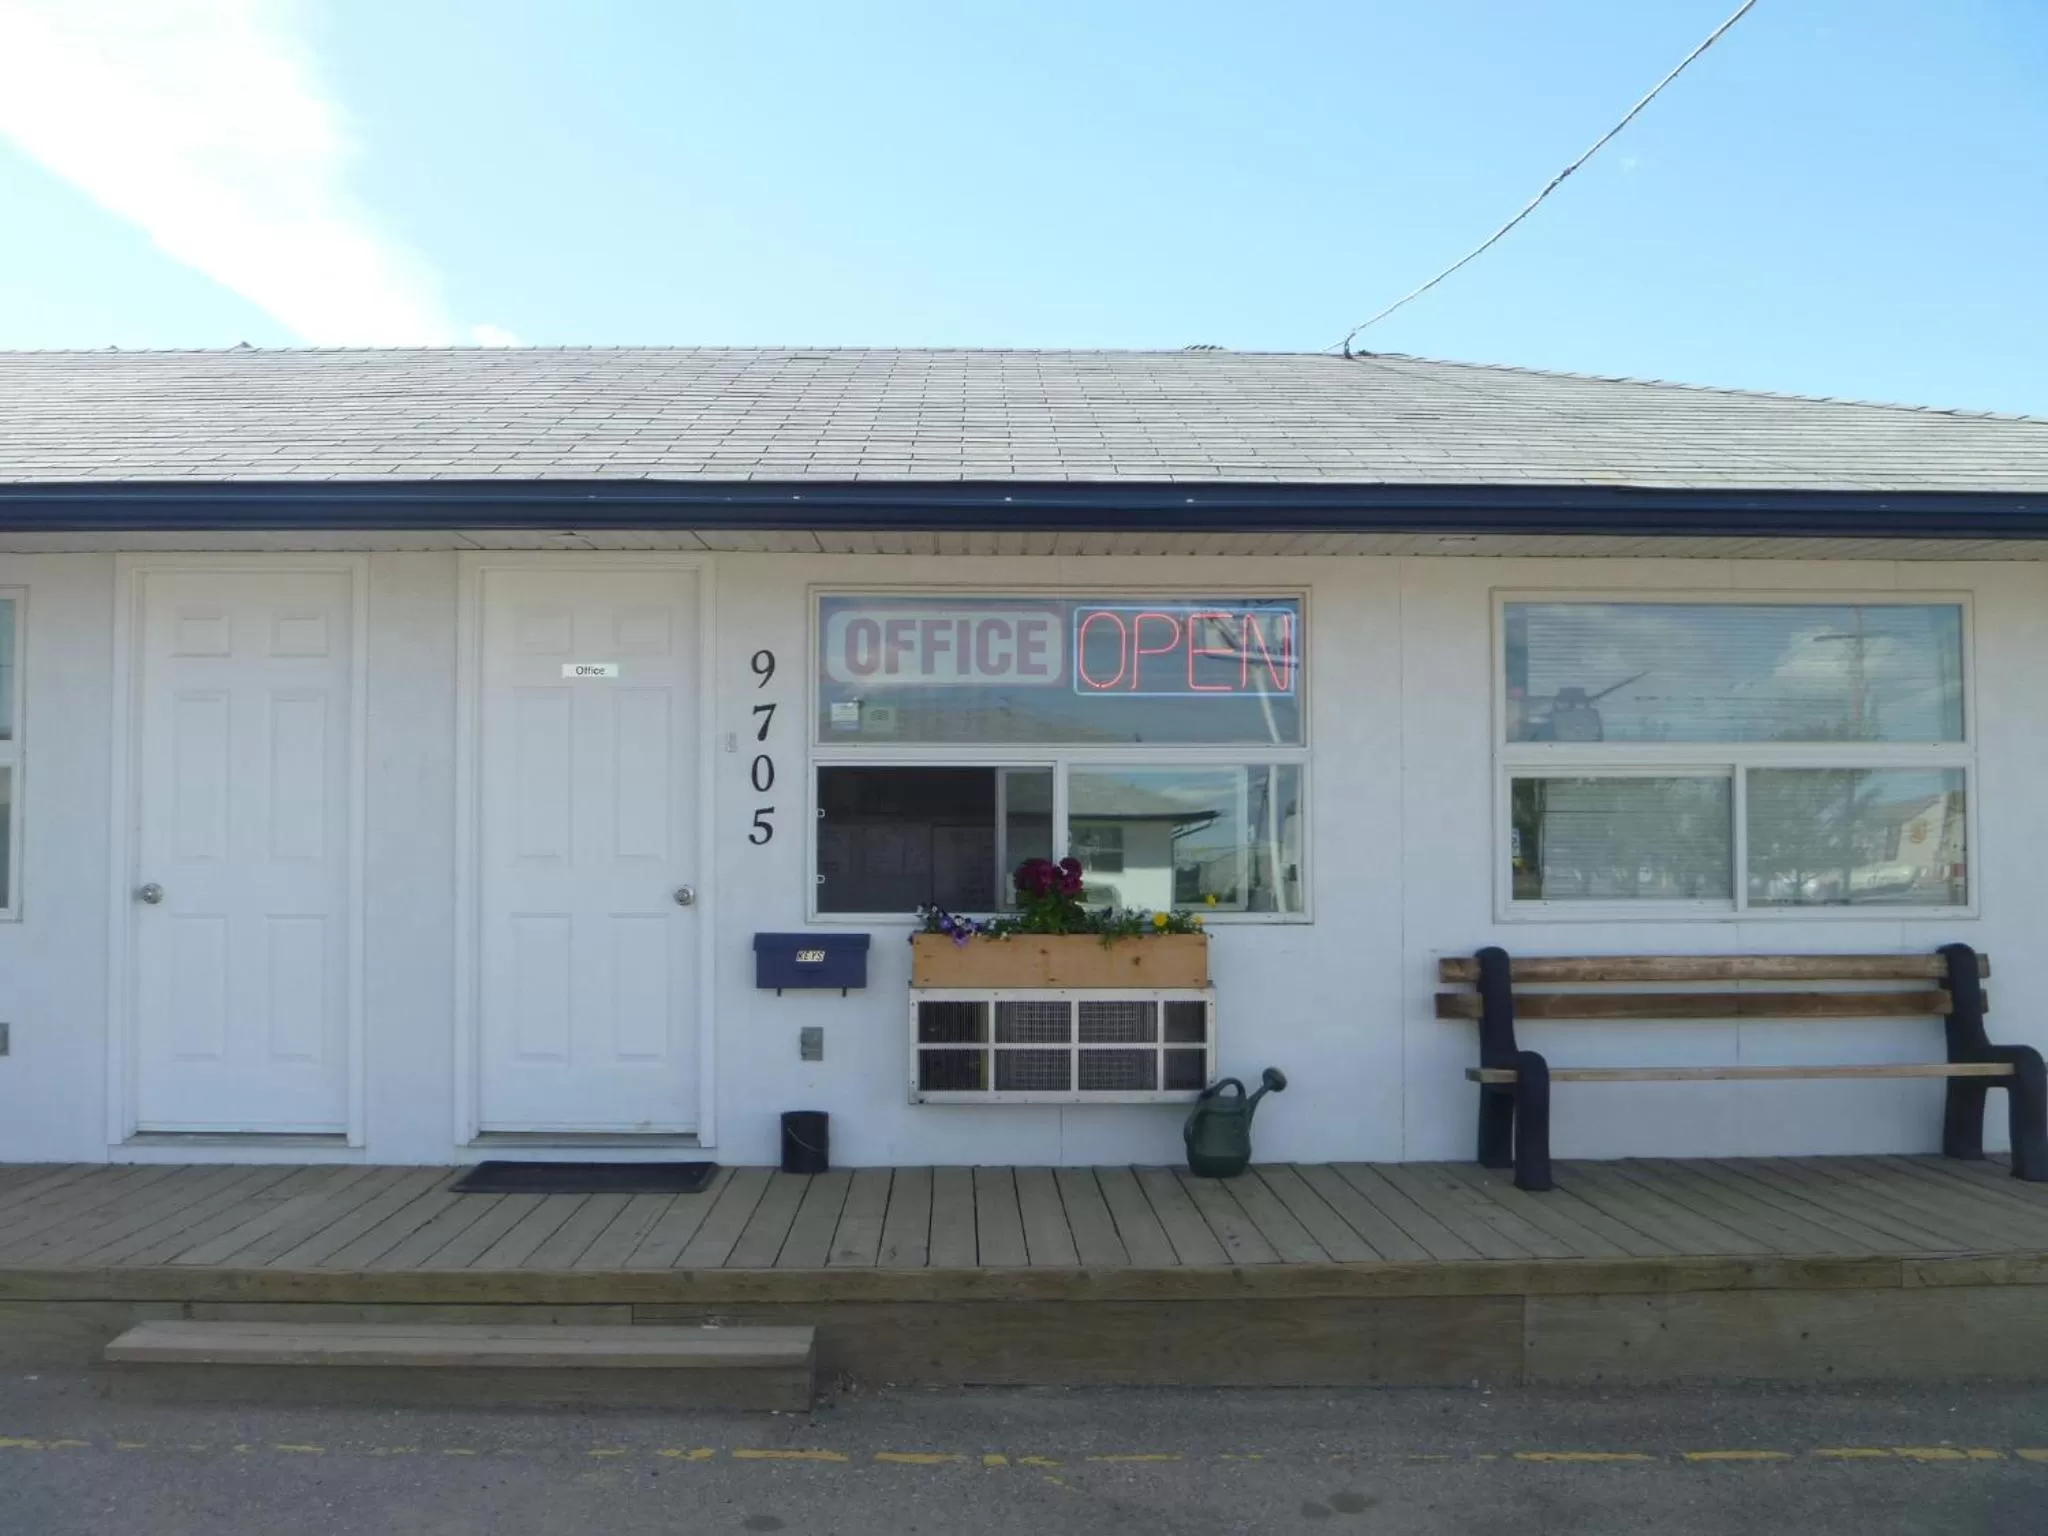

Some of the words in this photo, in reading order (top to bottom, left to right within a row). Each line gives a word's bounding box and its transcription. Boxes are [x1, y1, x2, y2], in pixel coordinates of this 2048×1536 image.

[575, 665, 606, 676] Office
[845, 618, 1048, 676] OFFICE
[1080, 612, 1289, 691] OPEN
[748, 650, 777, 845] 9705
